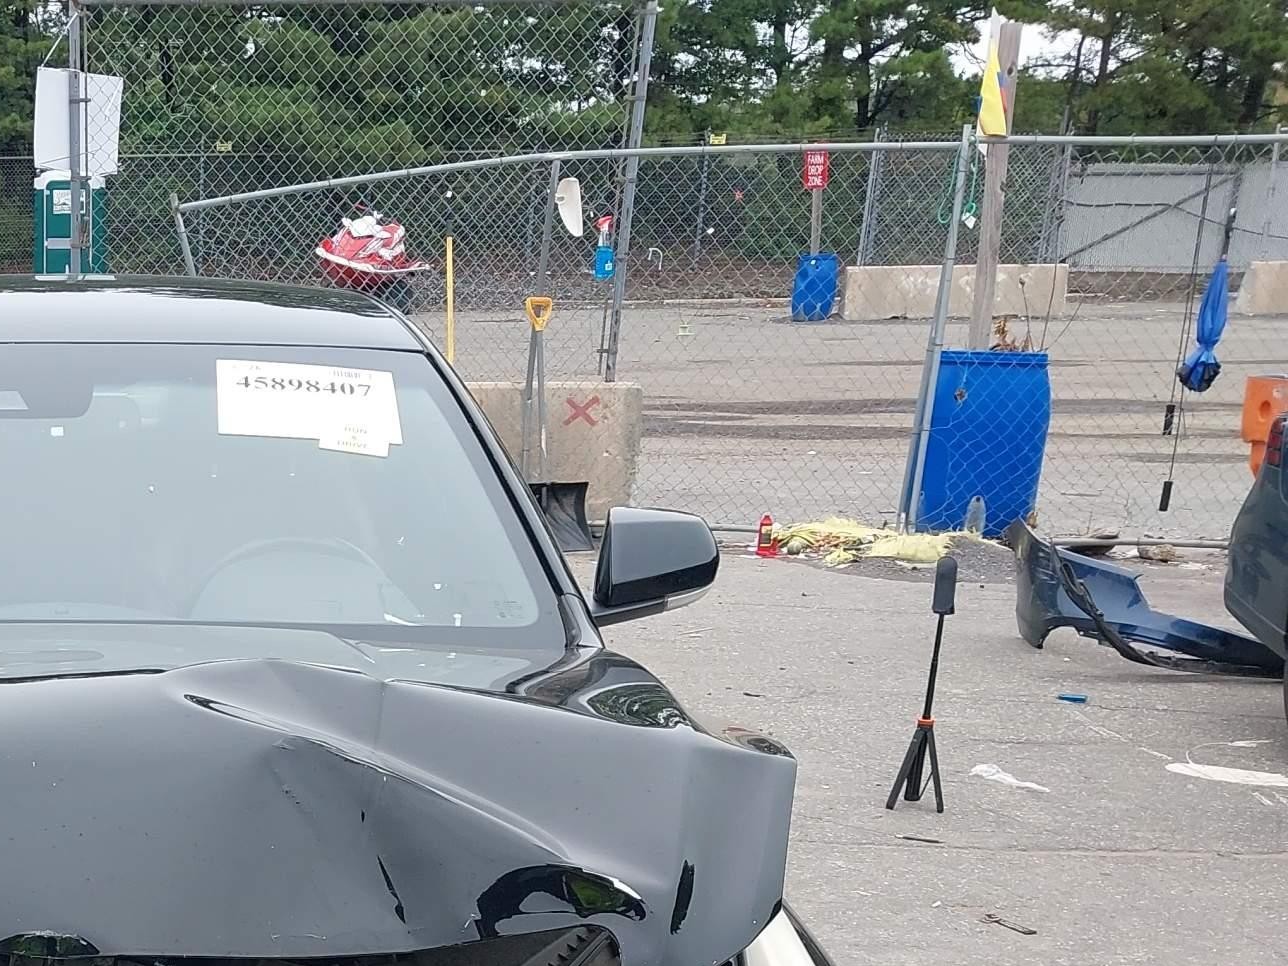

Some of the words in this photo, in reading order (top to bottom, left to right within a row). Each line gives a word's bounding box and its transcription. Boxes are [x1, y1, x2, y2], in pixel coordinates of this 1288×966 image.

[807, 165, 824, 175] DROP
[807, 176, 823, 186] ZONE
[236, 376, 372, 397] 45898407
